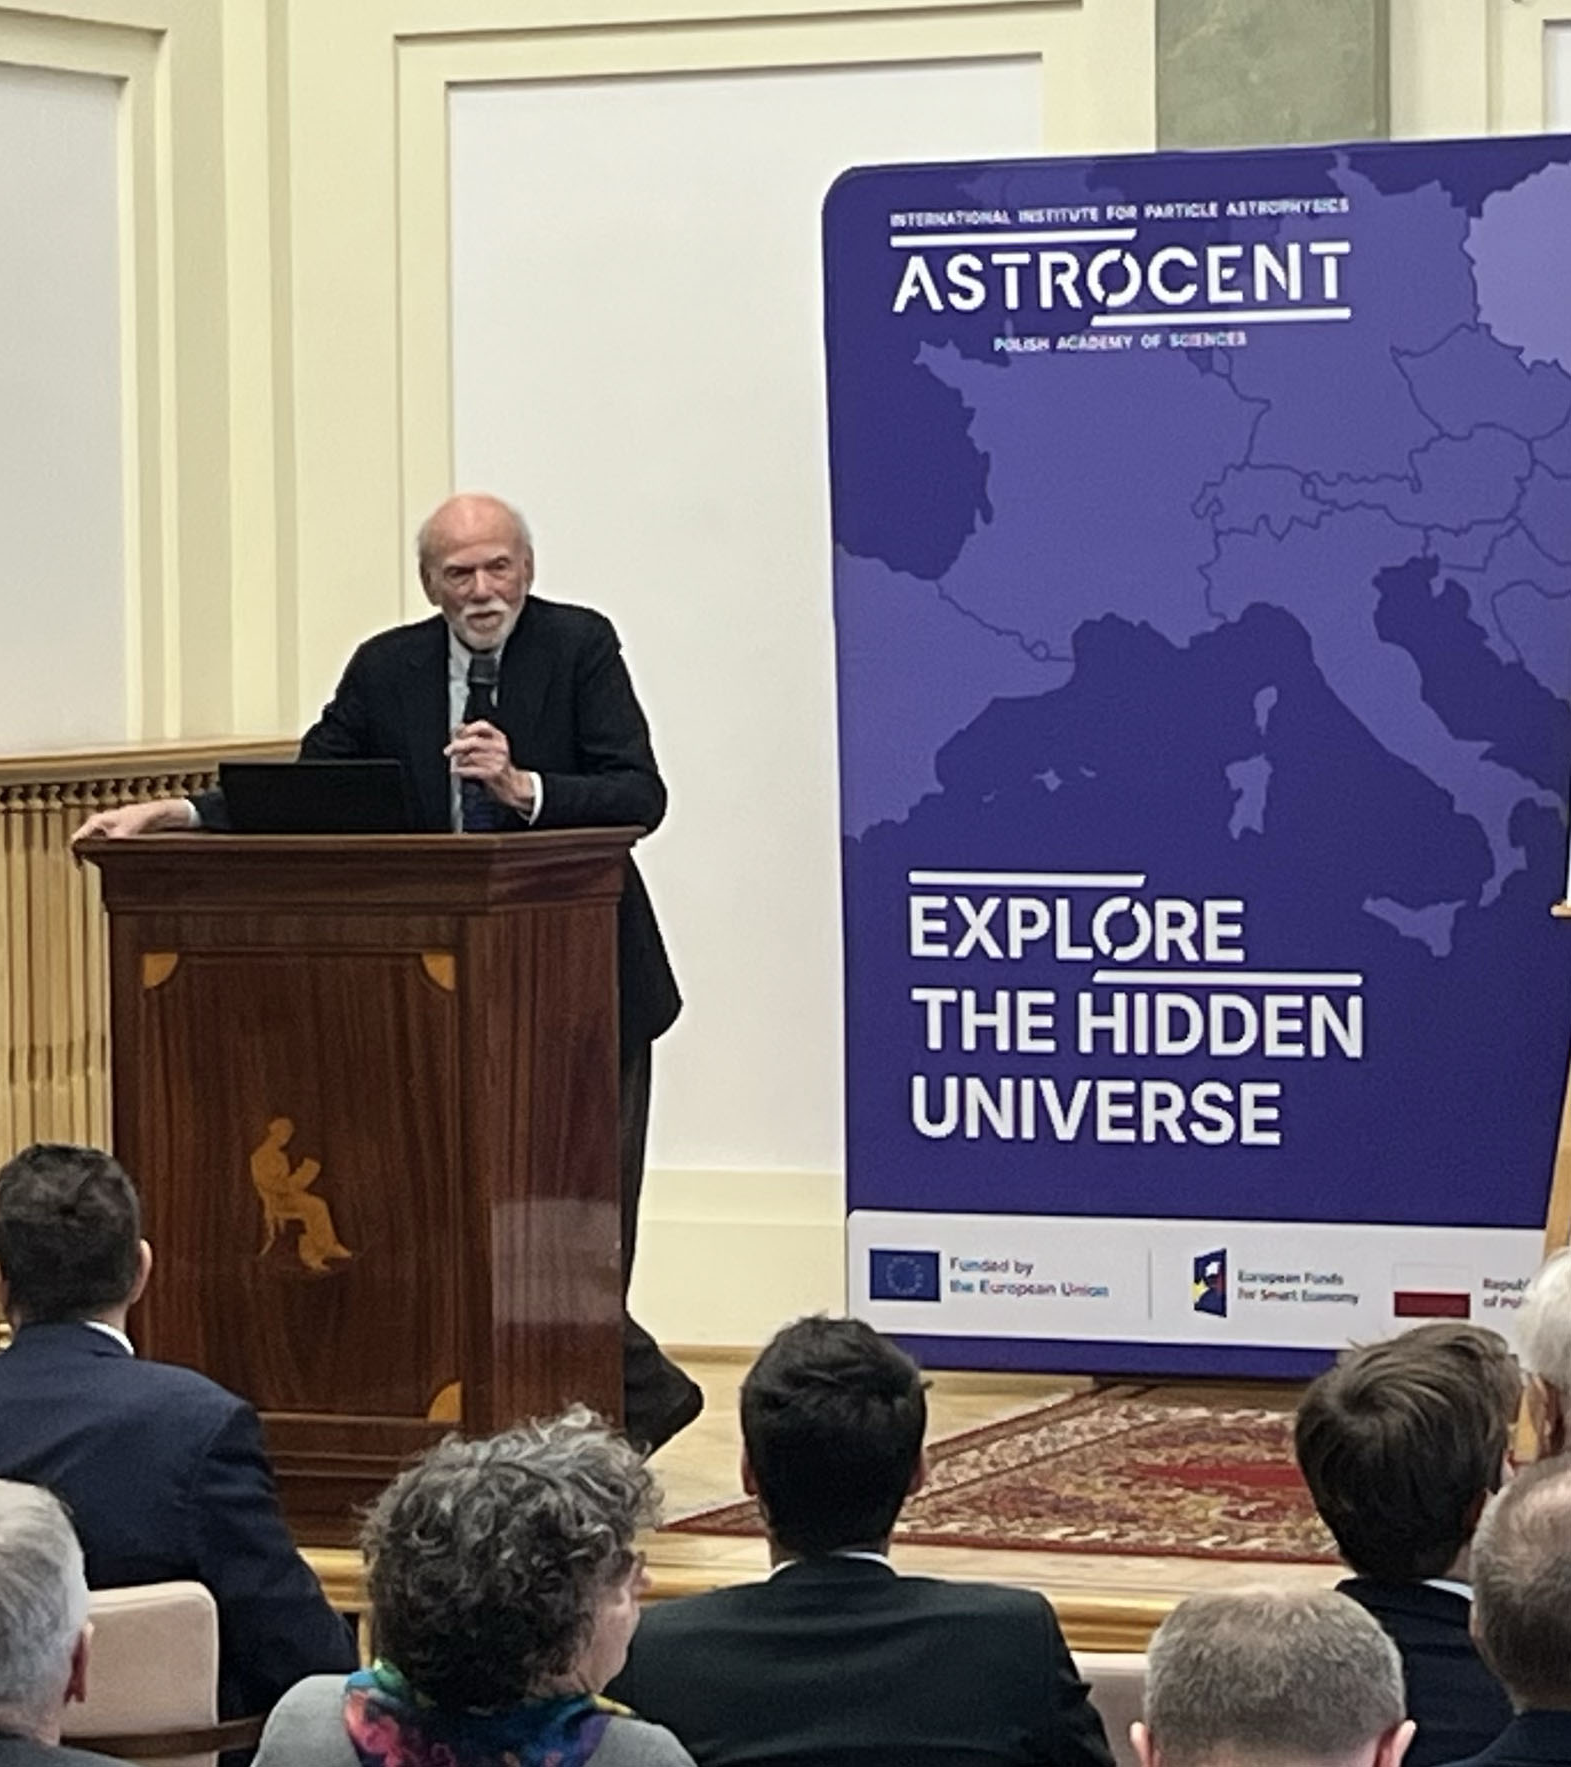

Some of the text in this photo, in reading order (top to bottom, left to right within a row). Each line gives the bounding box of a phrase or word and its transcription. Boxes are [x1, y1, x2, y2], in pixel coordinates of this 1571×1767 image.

[890, 198, 1349, 227] INTERNATIONAL INSTITUTE FOR PARTICLE ASTROPHYSICS
[892, 241, 1351, 313] ASTROCENT
[993, 330, 1247, 352] POLISH ACADEMY OF SCIENCES
[909, 896, 1244, 962] EXPLORE
[911, 988, 1363, 1059] THE HIDDEN
[912, 1075, 1281, 1145] UNIVERSE
[950, 1257, 1034, 1276] Funded by
[1238, 1269, 1345, 1286] European Funds
[950, 1279, 1110, 1298] the European Union
[1238, 1288, 1360, 1306] for Smart Economy
[1483, 1295, 1499, 1308] of
